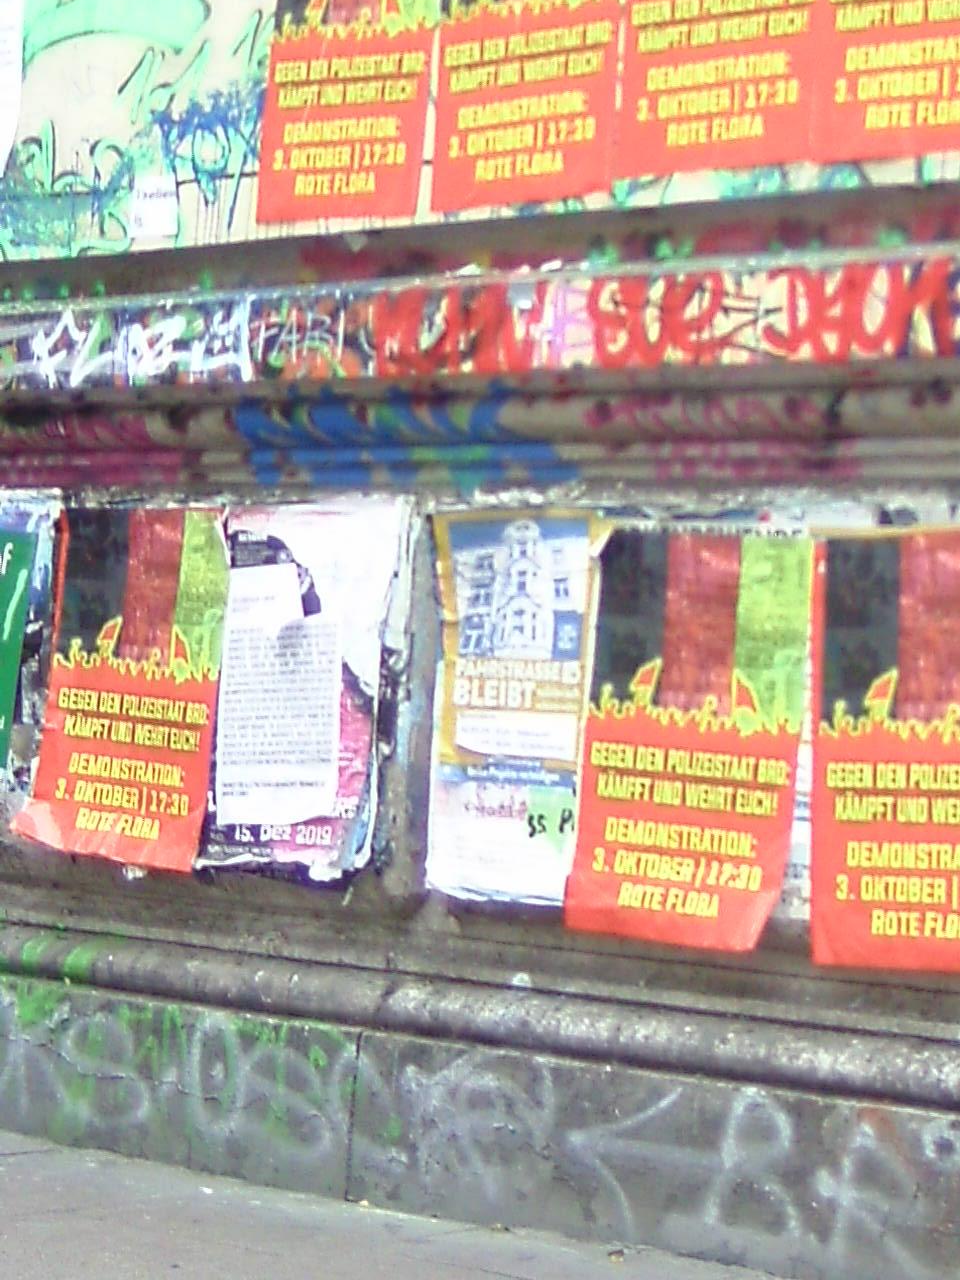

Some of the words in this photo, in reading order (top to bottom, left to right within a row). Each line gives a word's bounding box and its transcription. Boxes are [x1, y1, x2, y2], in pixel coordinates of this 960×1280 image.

[58, 687, 99, 711] GEGEN
[99, 692, 121, 714] DEN
[122, 694, 185, 722] POLIZEISTAAT
[185, 702, 209, 725] BRD:
[453, 677, 537, 709] BLEIBT
[110, 721, 133, 743] UND
[134, 723, 170, 747] WEHRT
[170, 728, 200, 751] EUCH!
[591, 741, 635, 769] GEGEN
[635, 746, 665, 772] DEN
[667, 749, 755, 781] POLIZEISTAAT
[757, 758, 790, 786] BRD:
[826, 762, 874, 788] GEGEN
[876, 763, 907, 789] DEN
[56, 778, 70, 800] 3.
[74, 780, 139, 809] OKTOBER
[150, 790, 189, 816] 17:30
[653, 780, 683, 806] UND
[685, 783, 734, 811] WEHRT
[735, 788, 778, 816] EUCH!
[896, 797, 929, 823] UND
[75, 807, 114, 833] ROTE
[119, 815, 160, 840] FLORA
[295, 825, 332, 845] 2019
[592, 847, 610, 873] 3.
[613, 849, 694, 883] OKTOBER
[705, 861, 763, 892] 17:30
[619, 881, 665, 911] ROTE
[665, 887, 719, 918] FLORA
[836, 874, 855, 901] 3.
[860, 875, 947, 904] OKTOBER
[871, 909, 920, 937] ROTE
